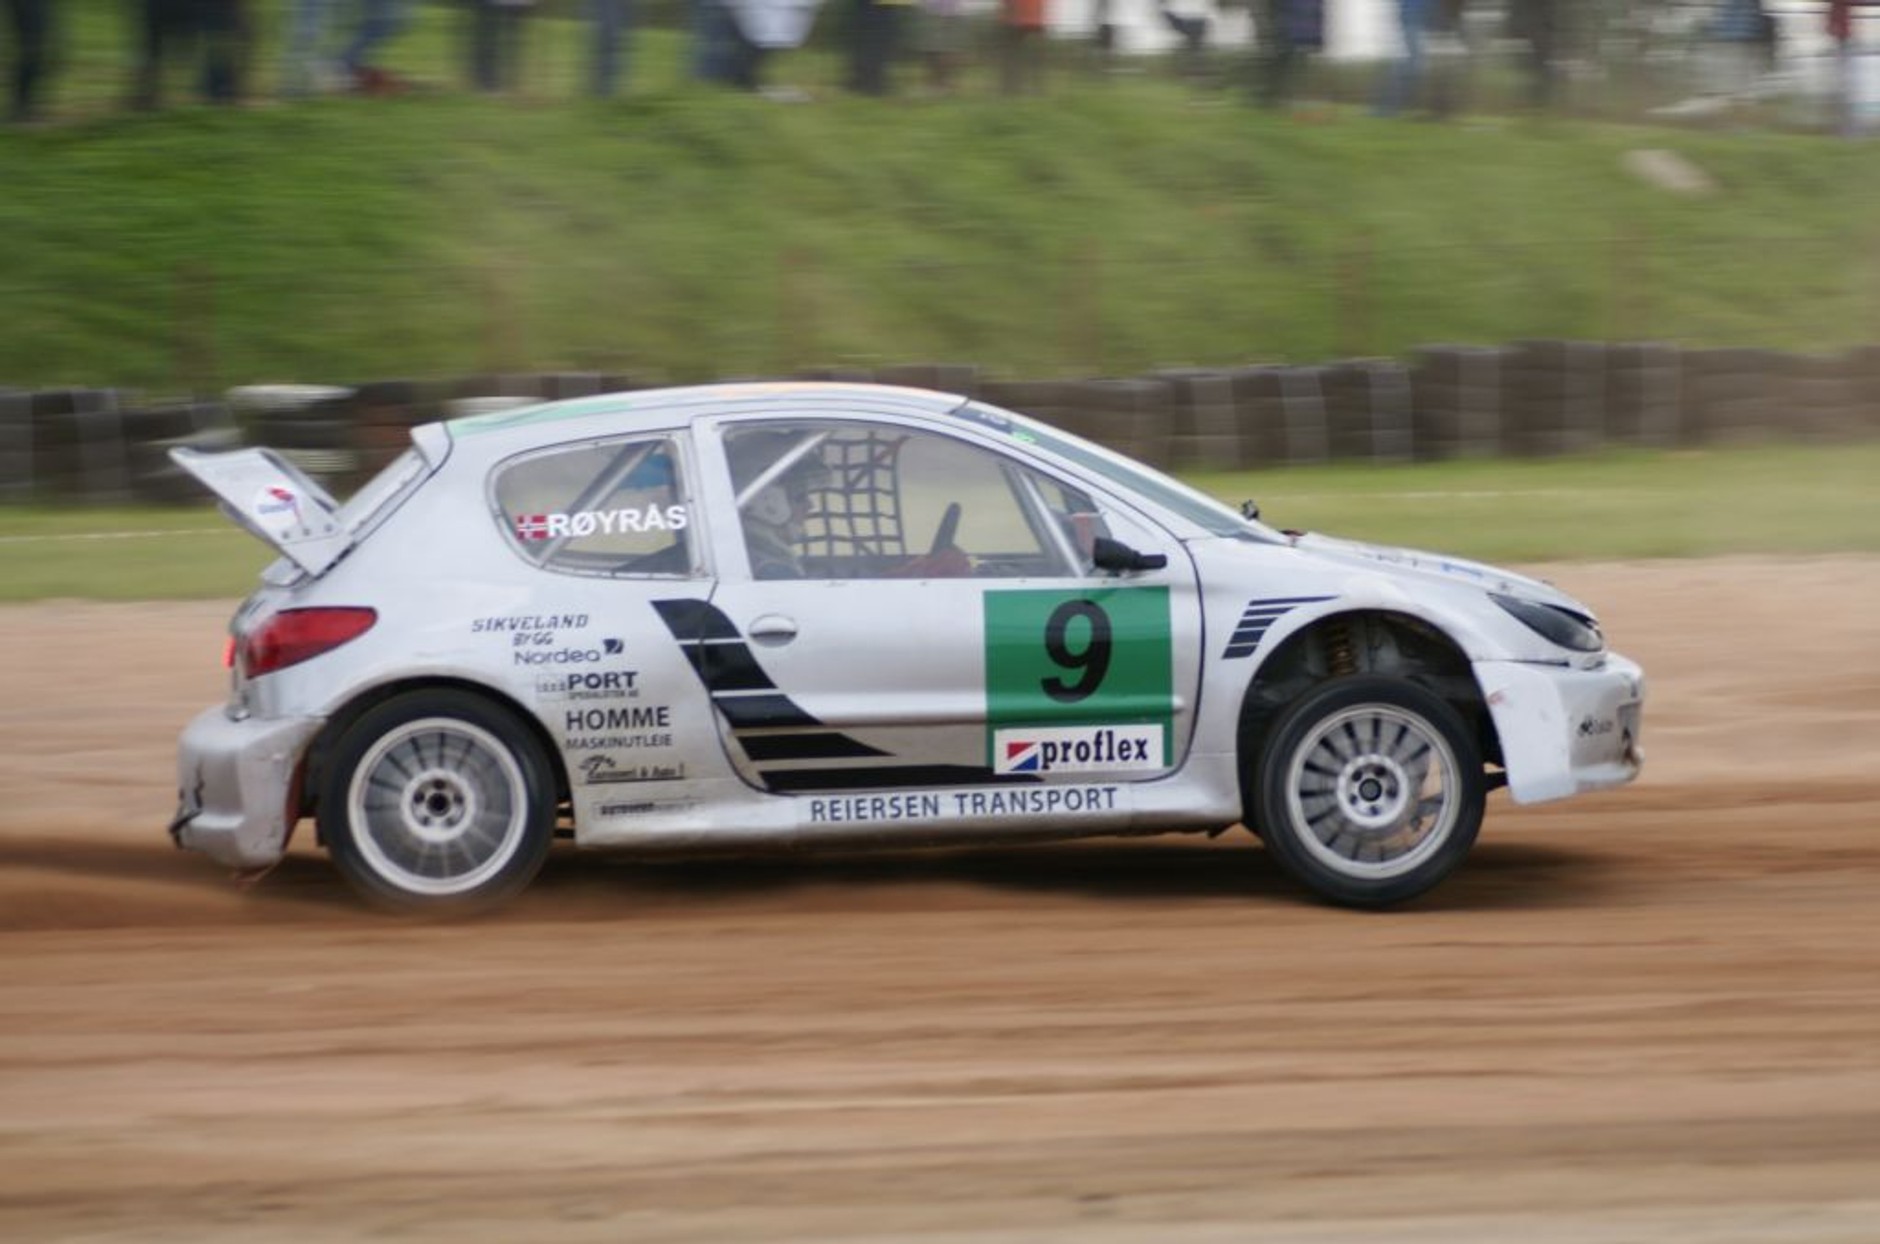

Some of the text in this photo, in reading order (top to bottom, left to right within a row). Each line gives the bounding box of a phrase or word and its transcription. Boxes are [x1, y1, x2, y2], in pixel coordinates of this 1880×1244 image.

[547, 503, 688, 539] RØYRÅS
[472, 614, 589, 632] SIKVELAND
[514, 648, 601, 665] Nordea
[1040, 599, 1112, 704] 9
[568, 671, 638, 690] PORT
[566, 706, 671, 731] HOMME
[566, 734, 673, 751] MASKINUTLEIE
[1040, 730, 1149, 764] proflex
[810, 787, 1118, 822] REIERSEN TRANSPORT
